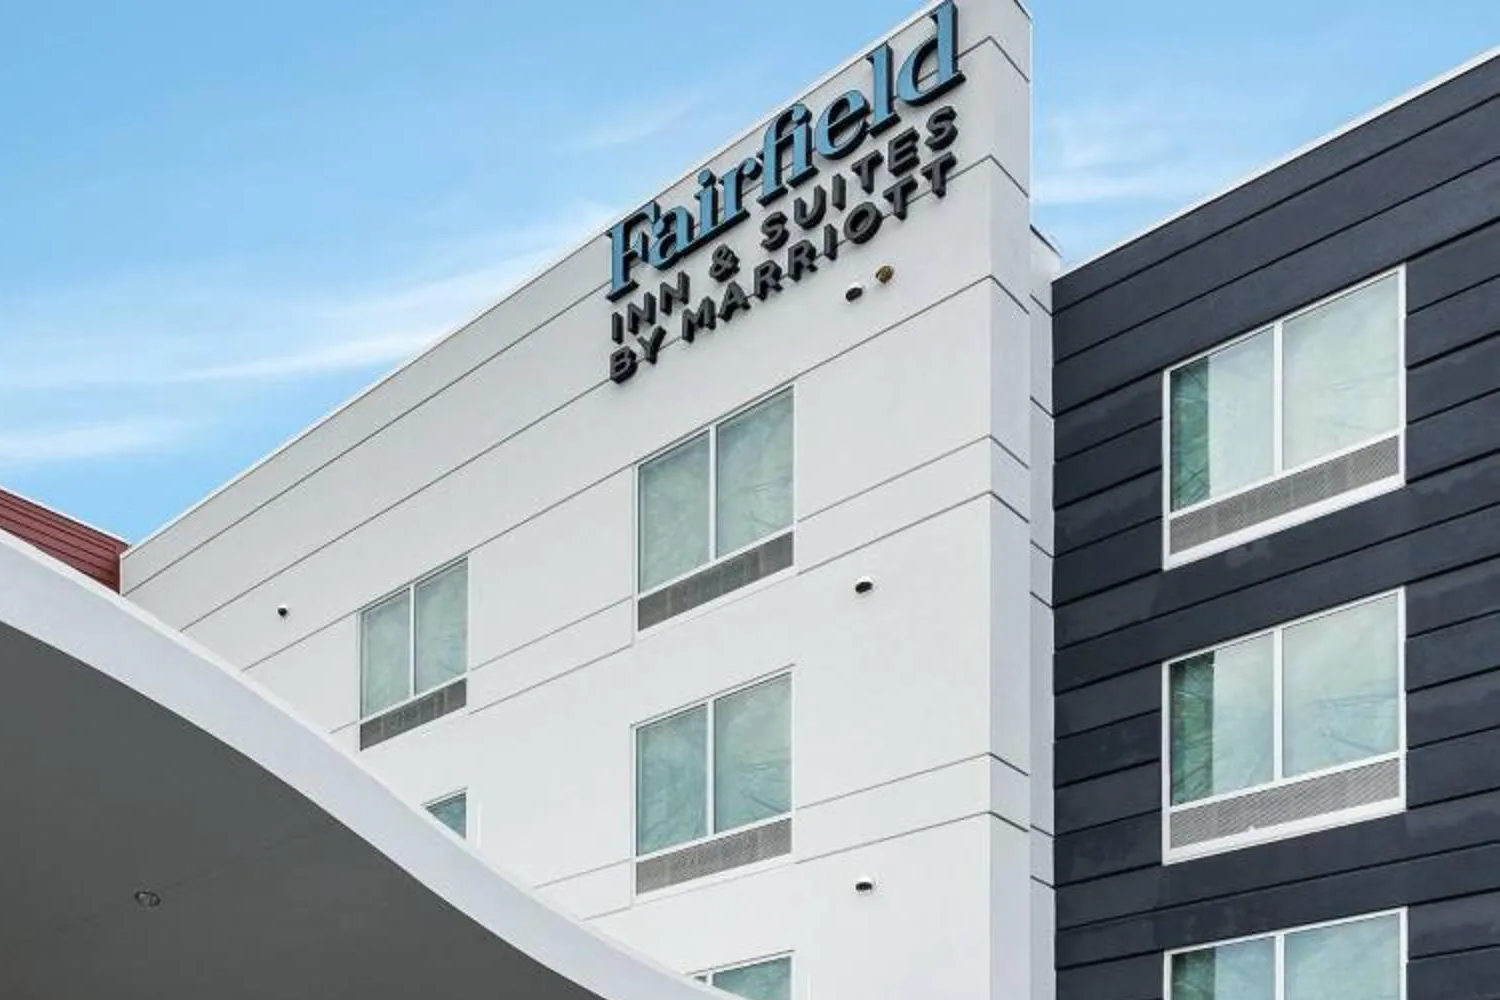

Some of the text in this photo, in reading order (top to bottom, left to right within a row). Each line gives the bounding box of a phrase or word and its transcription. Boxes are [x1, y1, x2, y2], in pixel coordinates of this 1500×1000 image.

[606, 0, 966, 301] Fairfield
[609, 151, 957, 383] BY MARRIOTT
[611, 105, 958, 345] INN & SUITES
